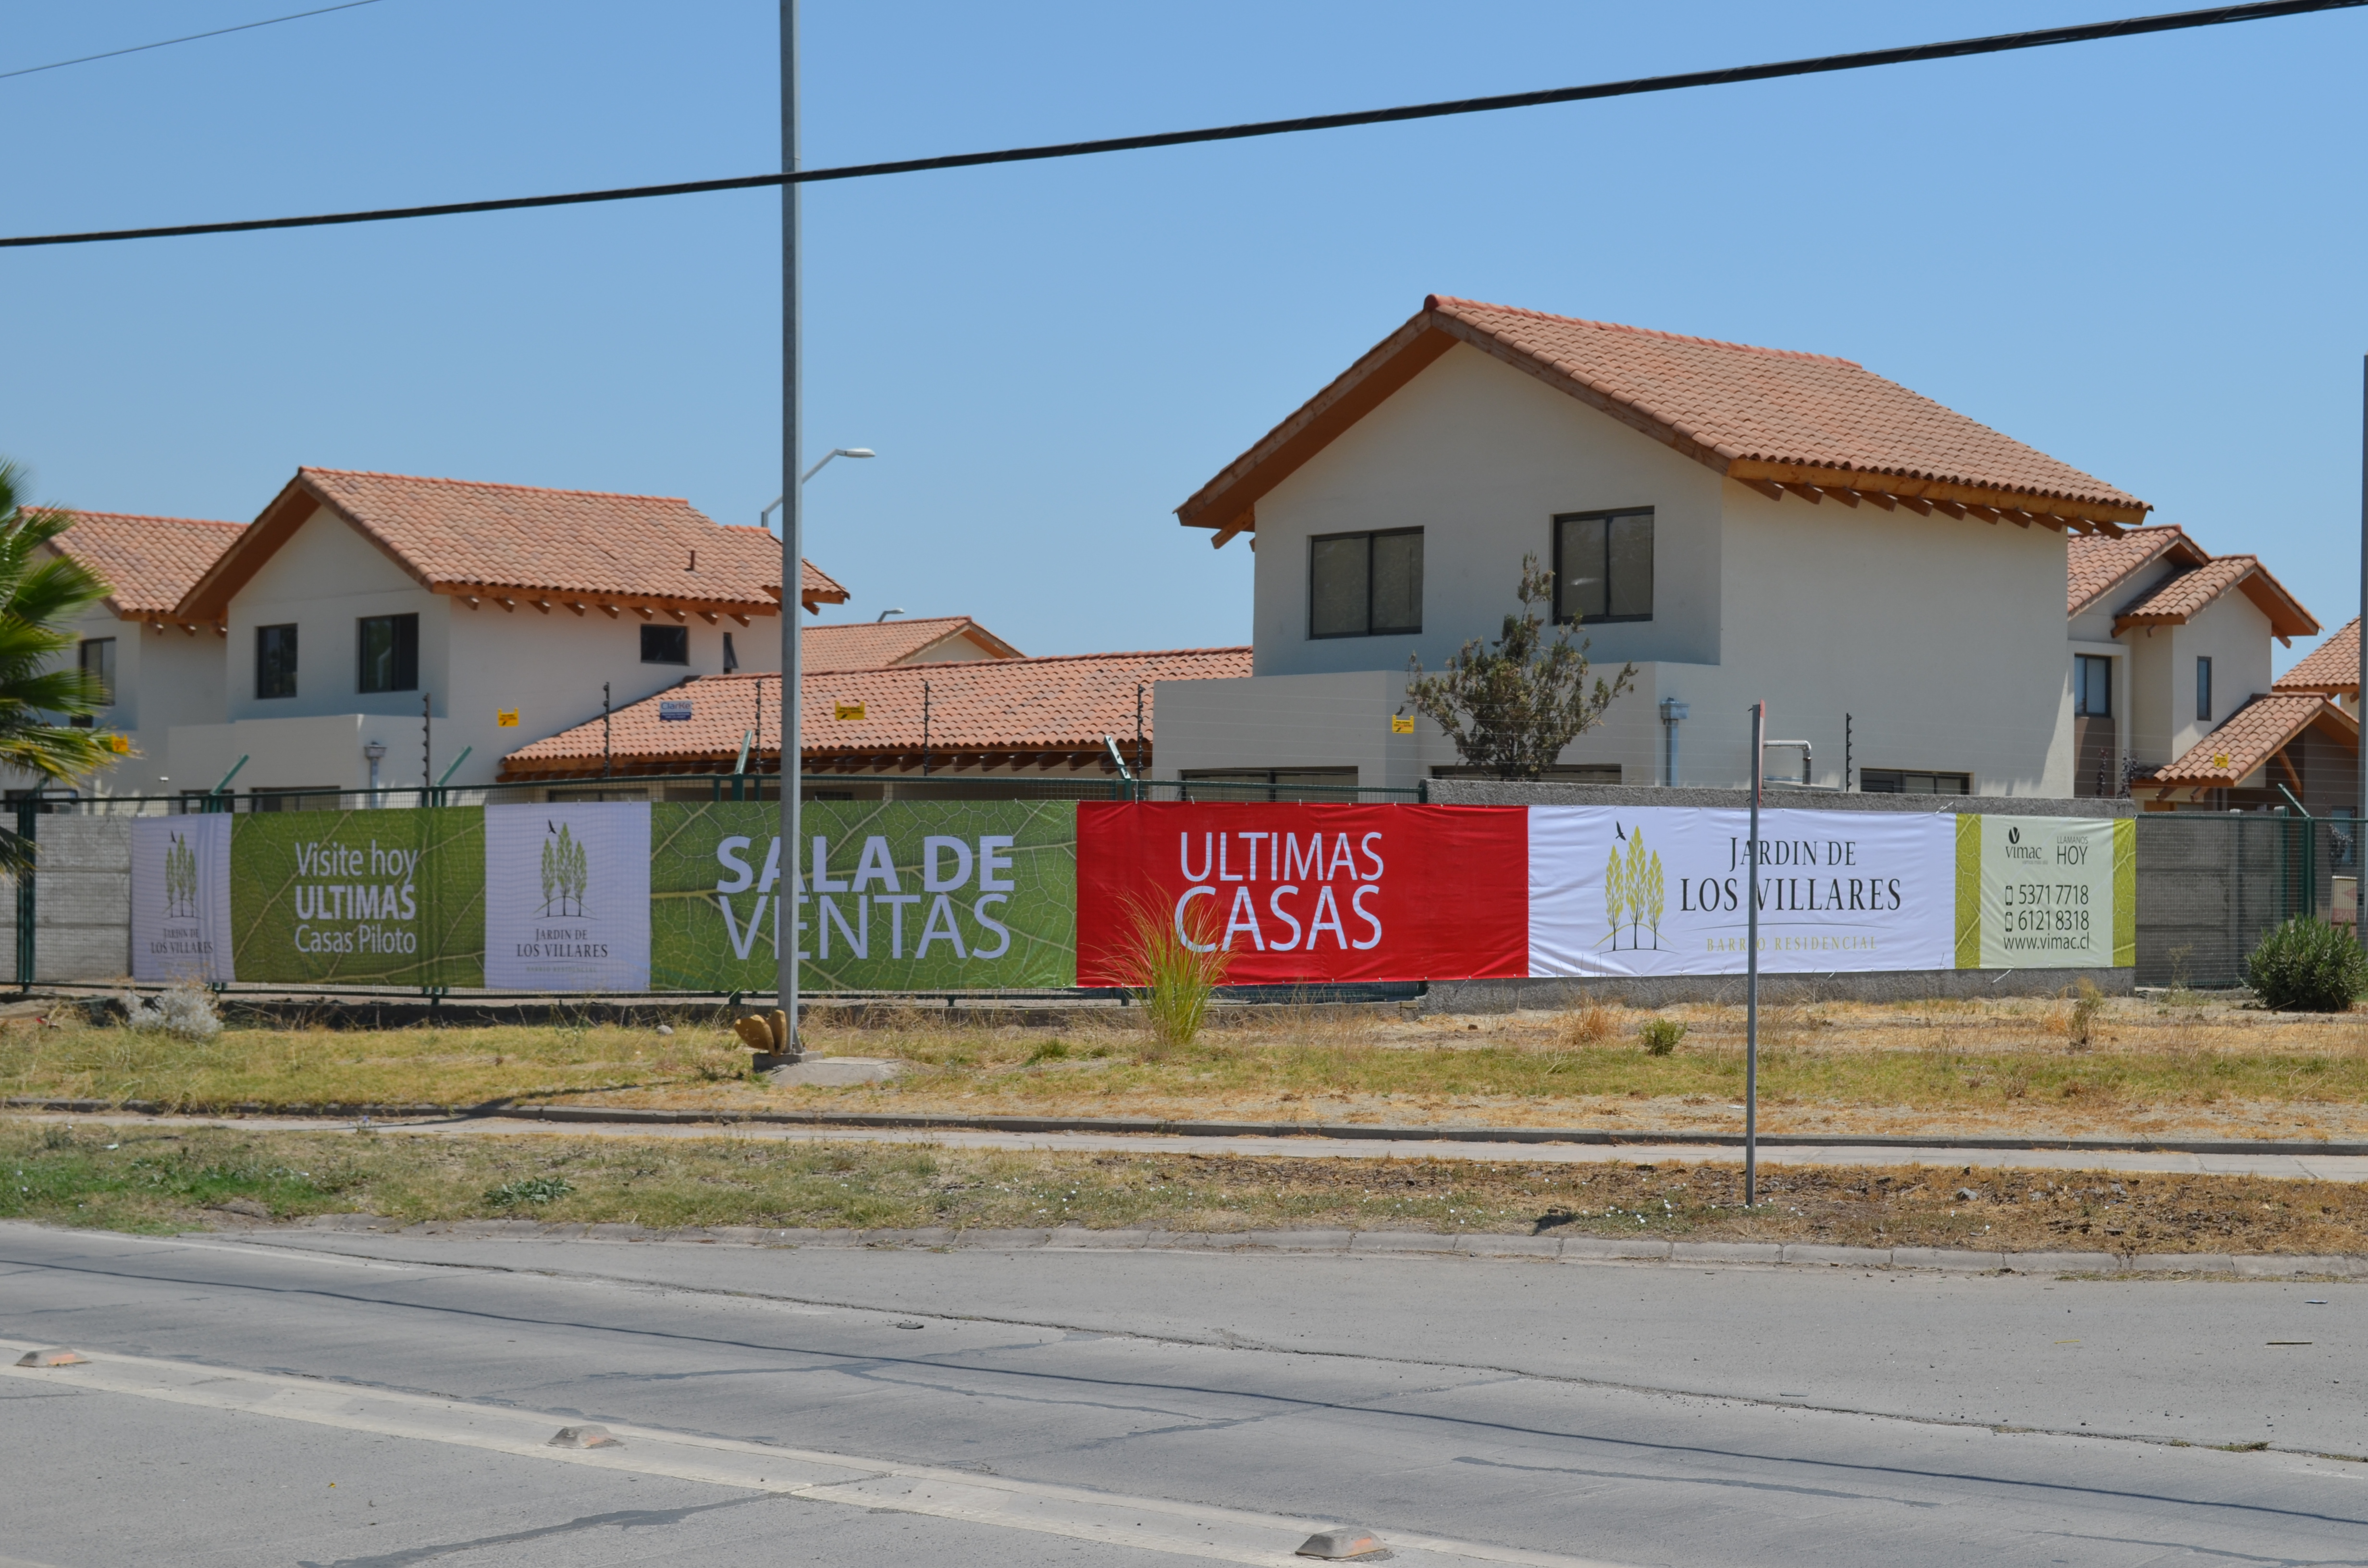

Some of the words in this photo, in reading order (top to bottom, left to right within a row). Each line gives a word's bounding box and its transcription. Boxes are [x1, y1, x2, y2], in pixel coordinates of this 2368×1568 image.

[2057, 836, 2088, 844] LLAMANOS
[295, 842, 363, 876] Visite
[371, 839, 418, 885] hoy
[1180, 832, 1384, 882] ULTIMAS
[1827, 841, 1856, 865] DE
[2006, 846, 2042, 859] vimac
[2057, 845, 2088, 865] HOY
[716, 835, 901, 894] SALA
[924, 835, 1014, 892] DE
[296, 884, 416, 920] ULTIMAS
[1680, 878, 1738, 912] LOS
[1757, 878, 1901, 911] VILLARES
[2019, 884, 2050, 905] 5371
[2056, 884, 2089, 905] 7718
[1173, 884, 1382, 953] CASAS
[2018, 910, 2050, 931] 6121
[2055, 910, 2089, 931] 8318
[295, 924, 353, 953] Casas
[359, 924, 417, 954] Piloto
[536, 929, 572, 942] JARDIN
[575, 930, 588, 940] DE
[1707, 937, 1766, 952] BARRO
[1775, 936, 1877, 950] RESIDENCIAL
[2003, 932, 2089, 949] www.vimac.cl
[151, 942, 168, 954] LOS
[170, 942, 213, 954] VILLARES
[517, 943, 540, 957] LOS
[544, 943, 608, 958] VILLARES
